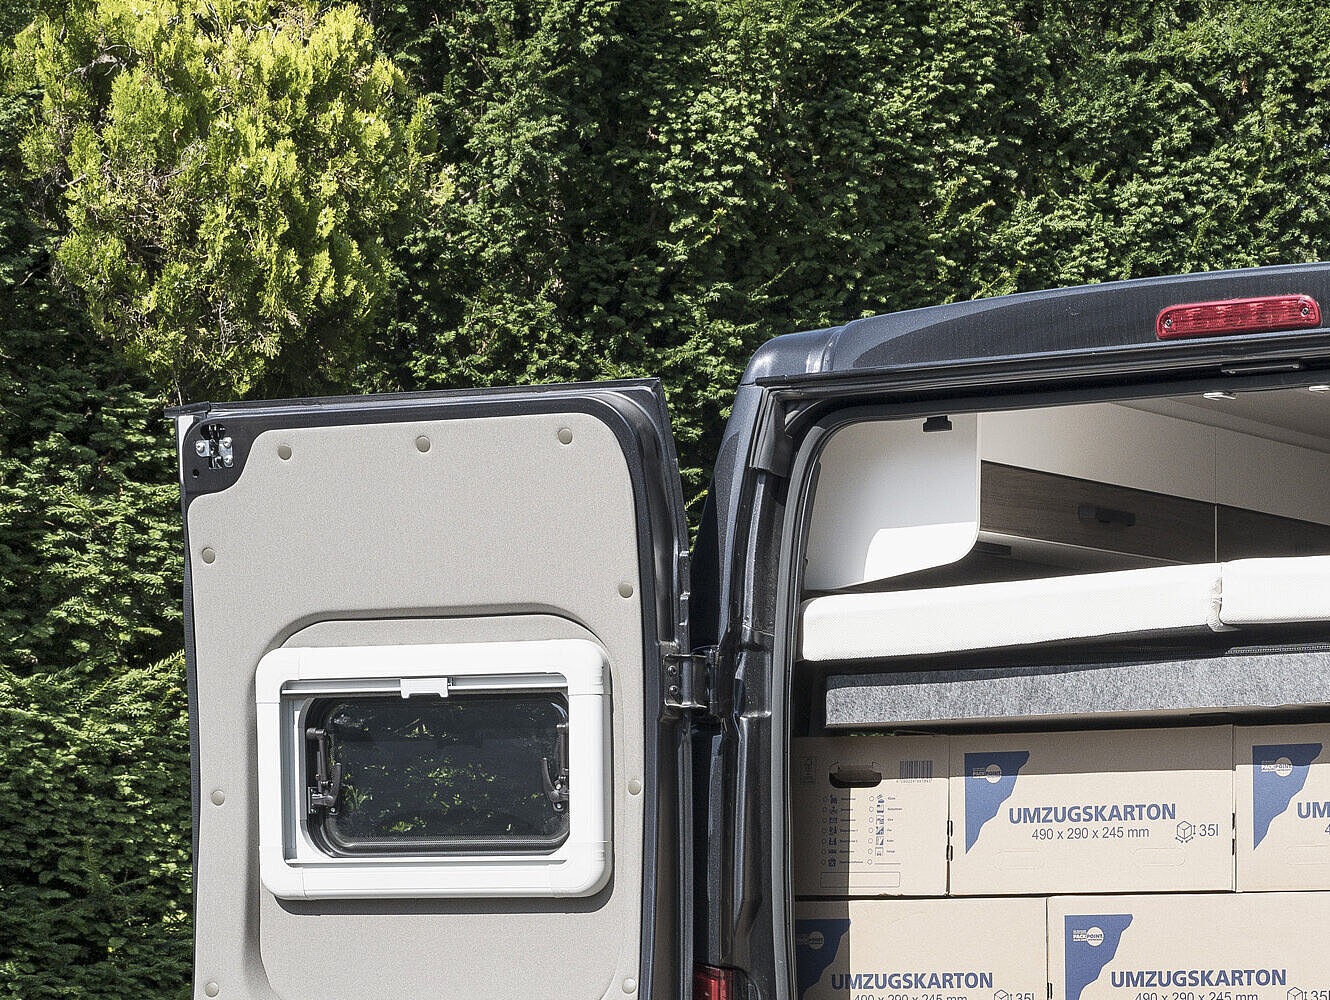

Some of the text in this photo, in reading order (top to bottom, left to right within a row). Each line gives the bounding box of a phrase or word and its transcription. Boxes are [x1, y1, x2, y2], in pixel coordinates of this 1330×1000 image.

[1009, 803, 1175, 824] UMZUGSKARTON
[1032, 827, 1149, 840] 490 x 290 x 245 mm
[832, 972, 993, 990] UMZUGSKARTON
[1112, 969, 1286, 987] UMZUGSKARTON
